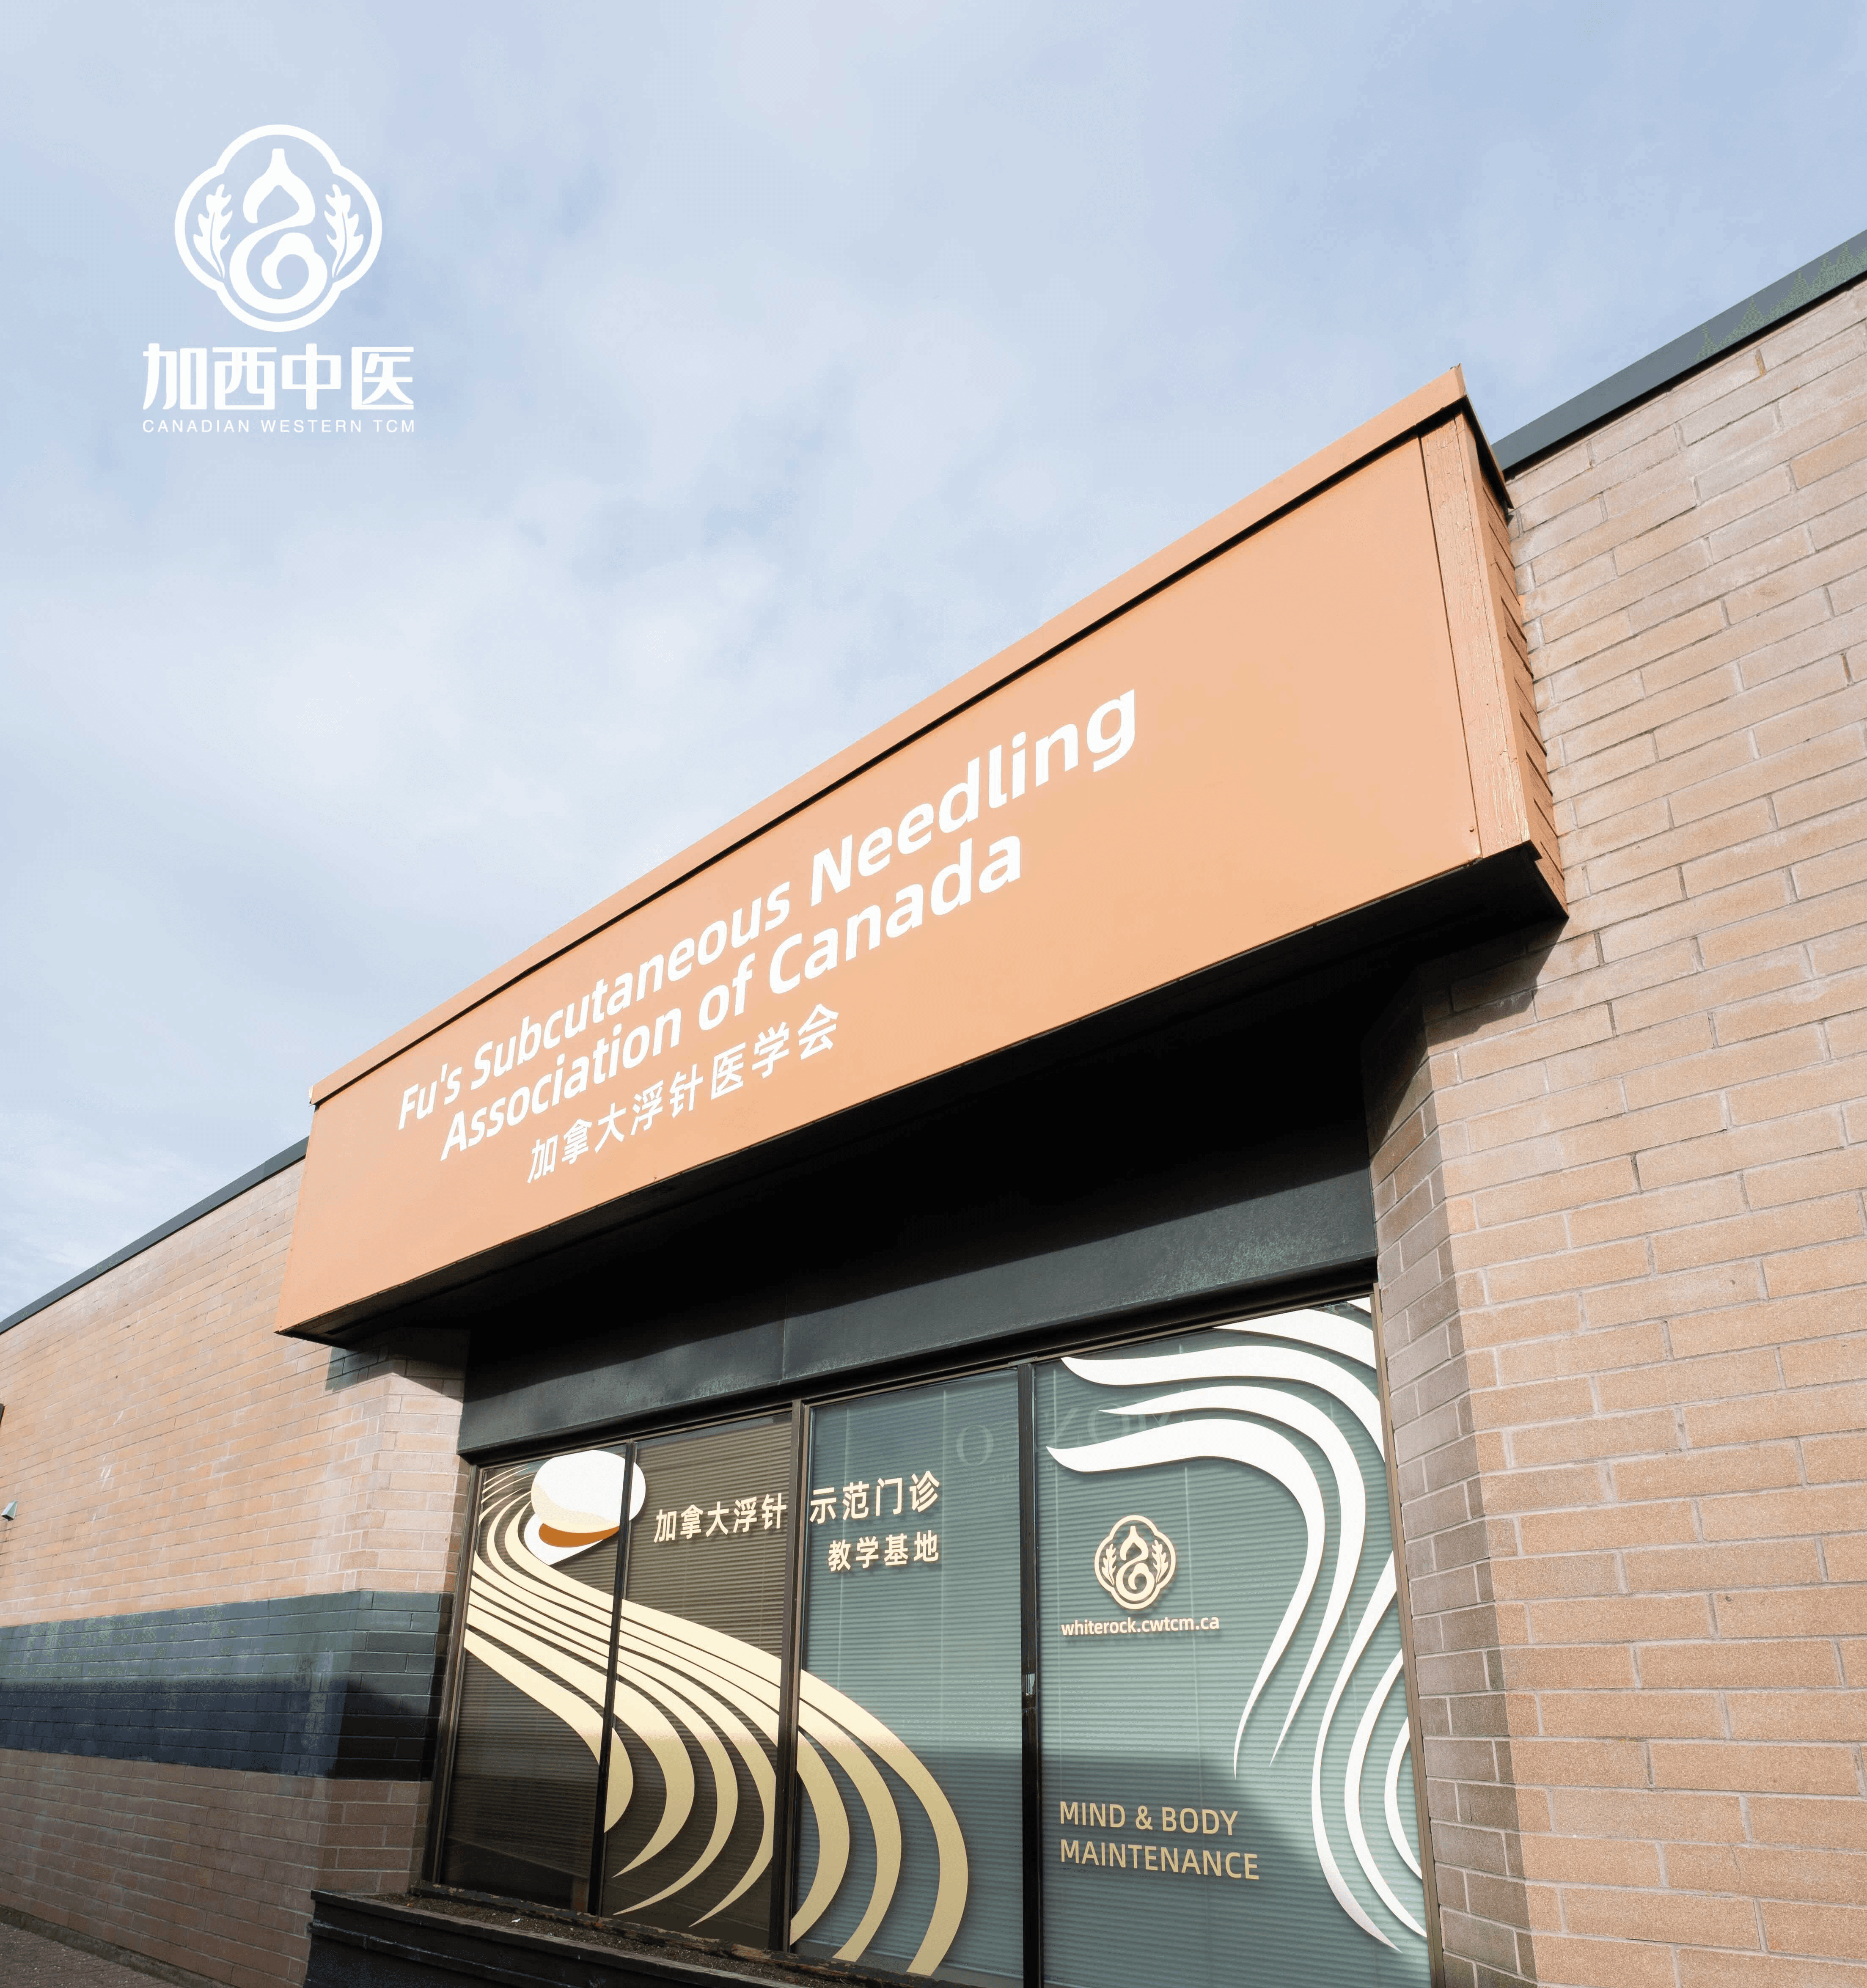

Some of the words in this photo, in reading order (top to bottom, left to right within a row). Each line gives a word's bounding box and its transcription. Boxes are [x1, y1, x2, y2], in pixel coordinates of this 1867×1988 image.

[398, 1063, 462, 1130] Fu's
[470, 881, 790, 1091] Subcutaneous
[811, 689, 1135, 907] Needling
[440, 1008, 682, 1162] Association
[698, 952, 755, 1031] of
[769, 835, 1021, 994] Canada
[527, 1003, 839, 1184] 加拿大浮针医学会
[653, 1492, 787, 1543] 加拿大浮针
[809, 1470, 940, 1524] 示范门诊
[828, 1529, 939, 1572] 教学基地
[1060, 1616, 1220, 1636] whiterock.cwtcm.ca
[1060, 1801, 1126, 1828] MIND
[1135, 1805, 1153, 1830] &
[1161, 1807, 1238, 1836] BODY
[1061, 1839, 1259, 1880] MAINTENANCE
